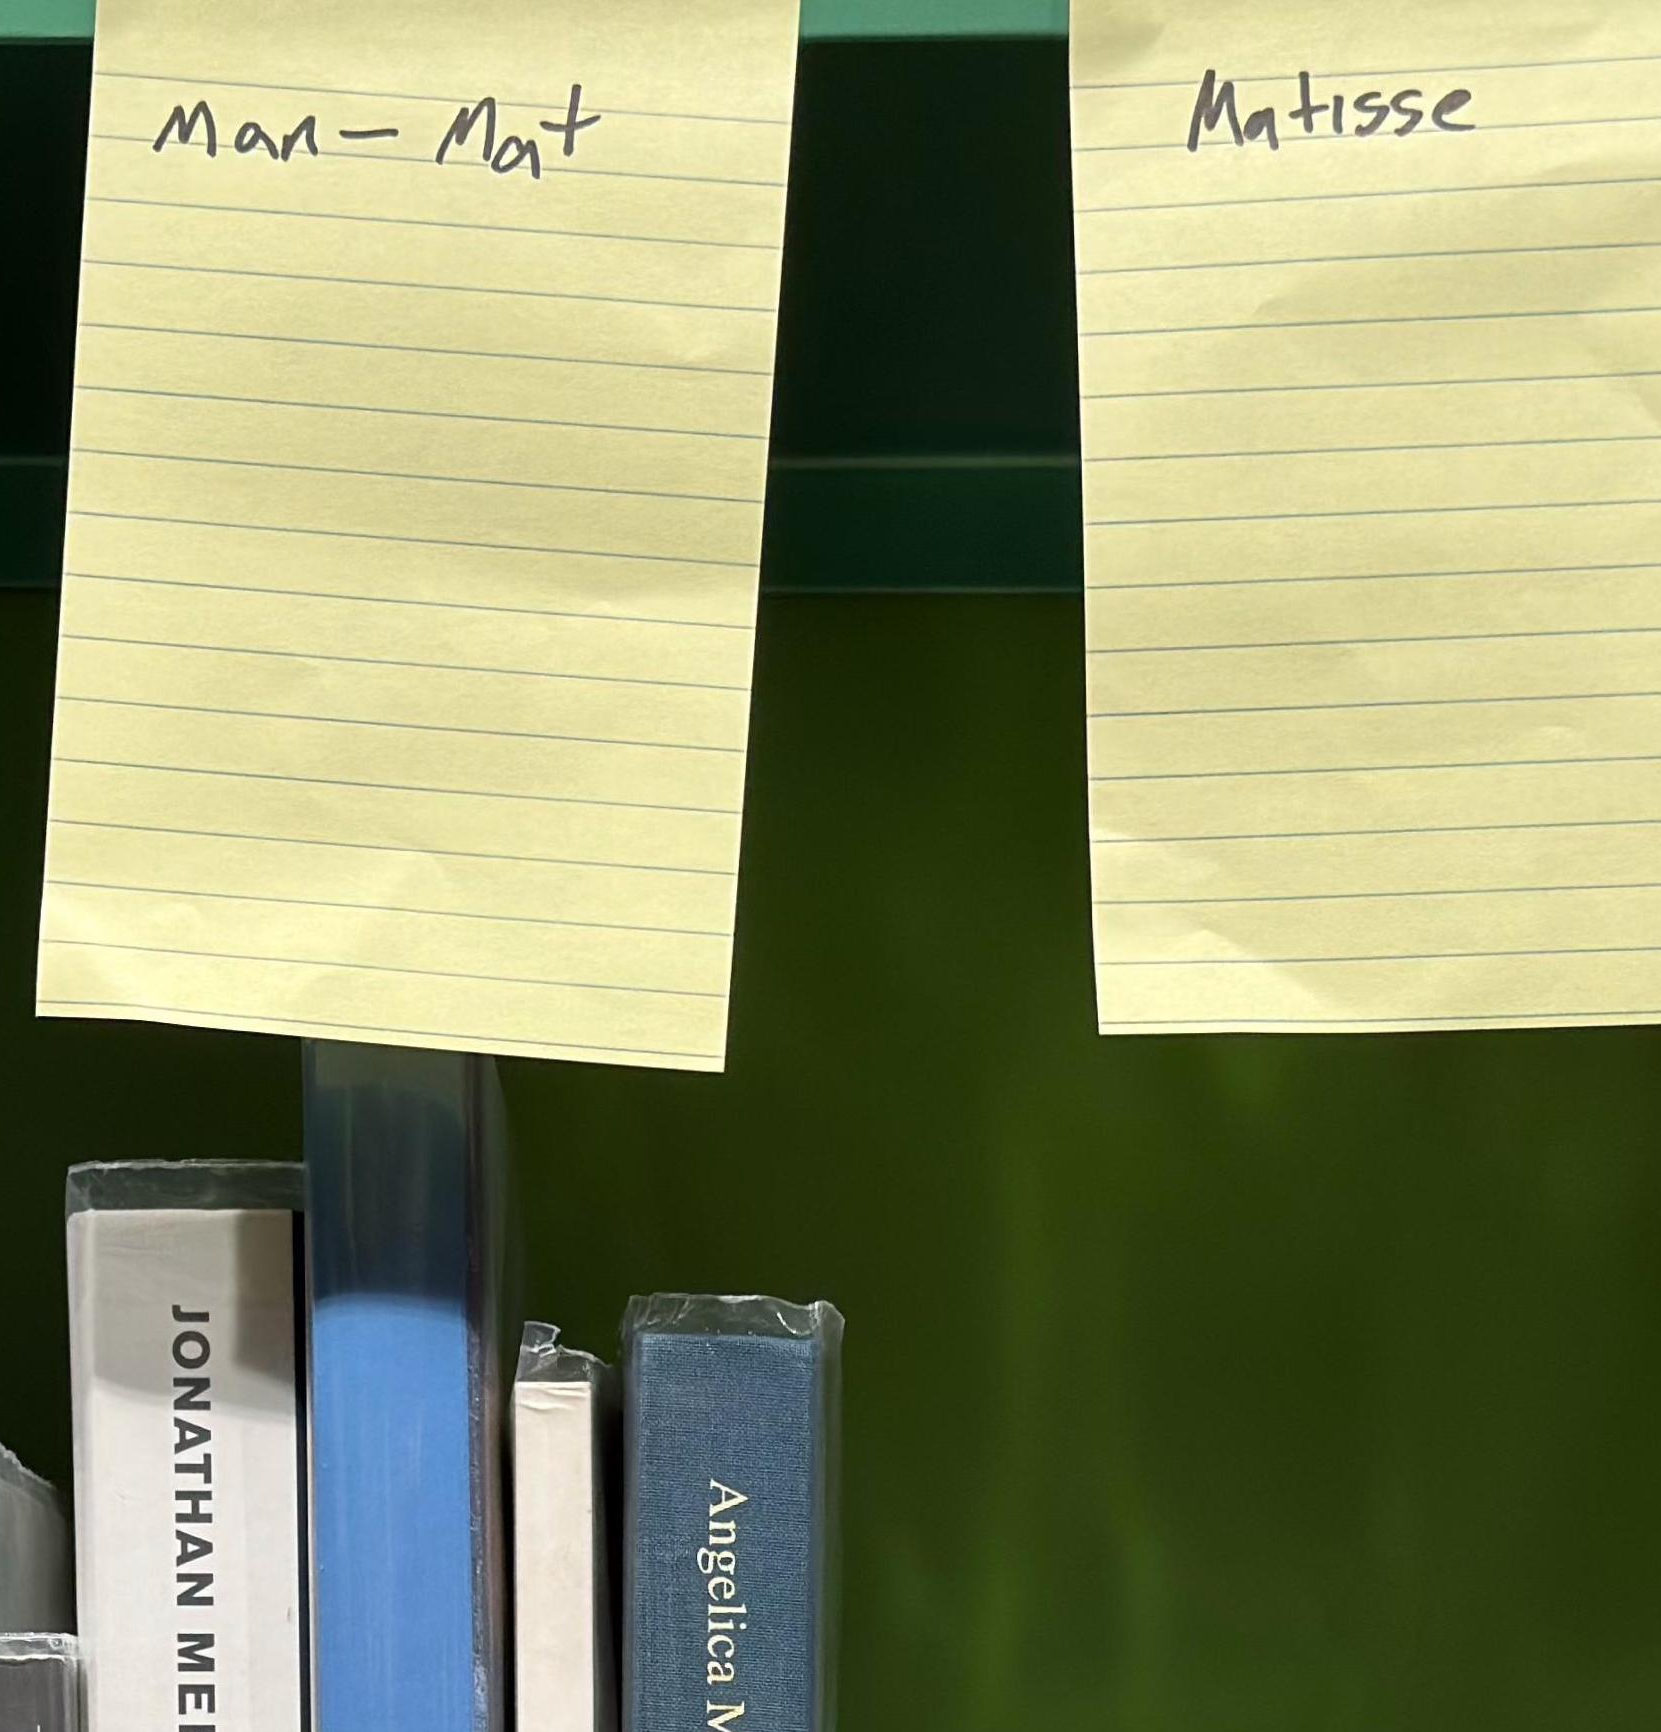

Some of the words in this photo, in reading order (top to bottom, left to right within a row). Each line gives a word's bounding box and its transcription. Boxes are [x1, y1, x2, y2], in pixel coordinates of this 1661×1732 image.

[153, 101, 318, 161] Man
[436, 84, 601, 179] Mat
[1188, 70, 1473, 150] Matisse
[172, 1305, 213, 1606] JONATHAN
[697, 1479, 748, 1685] Angelica
